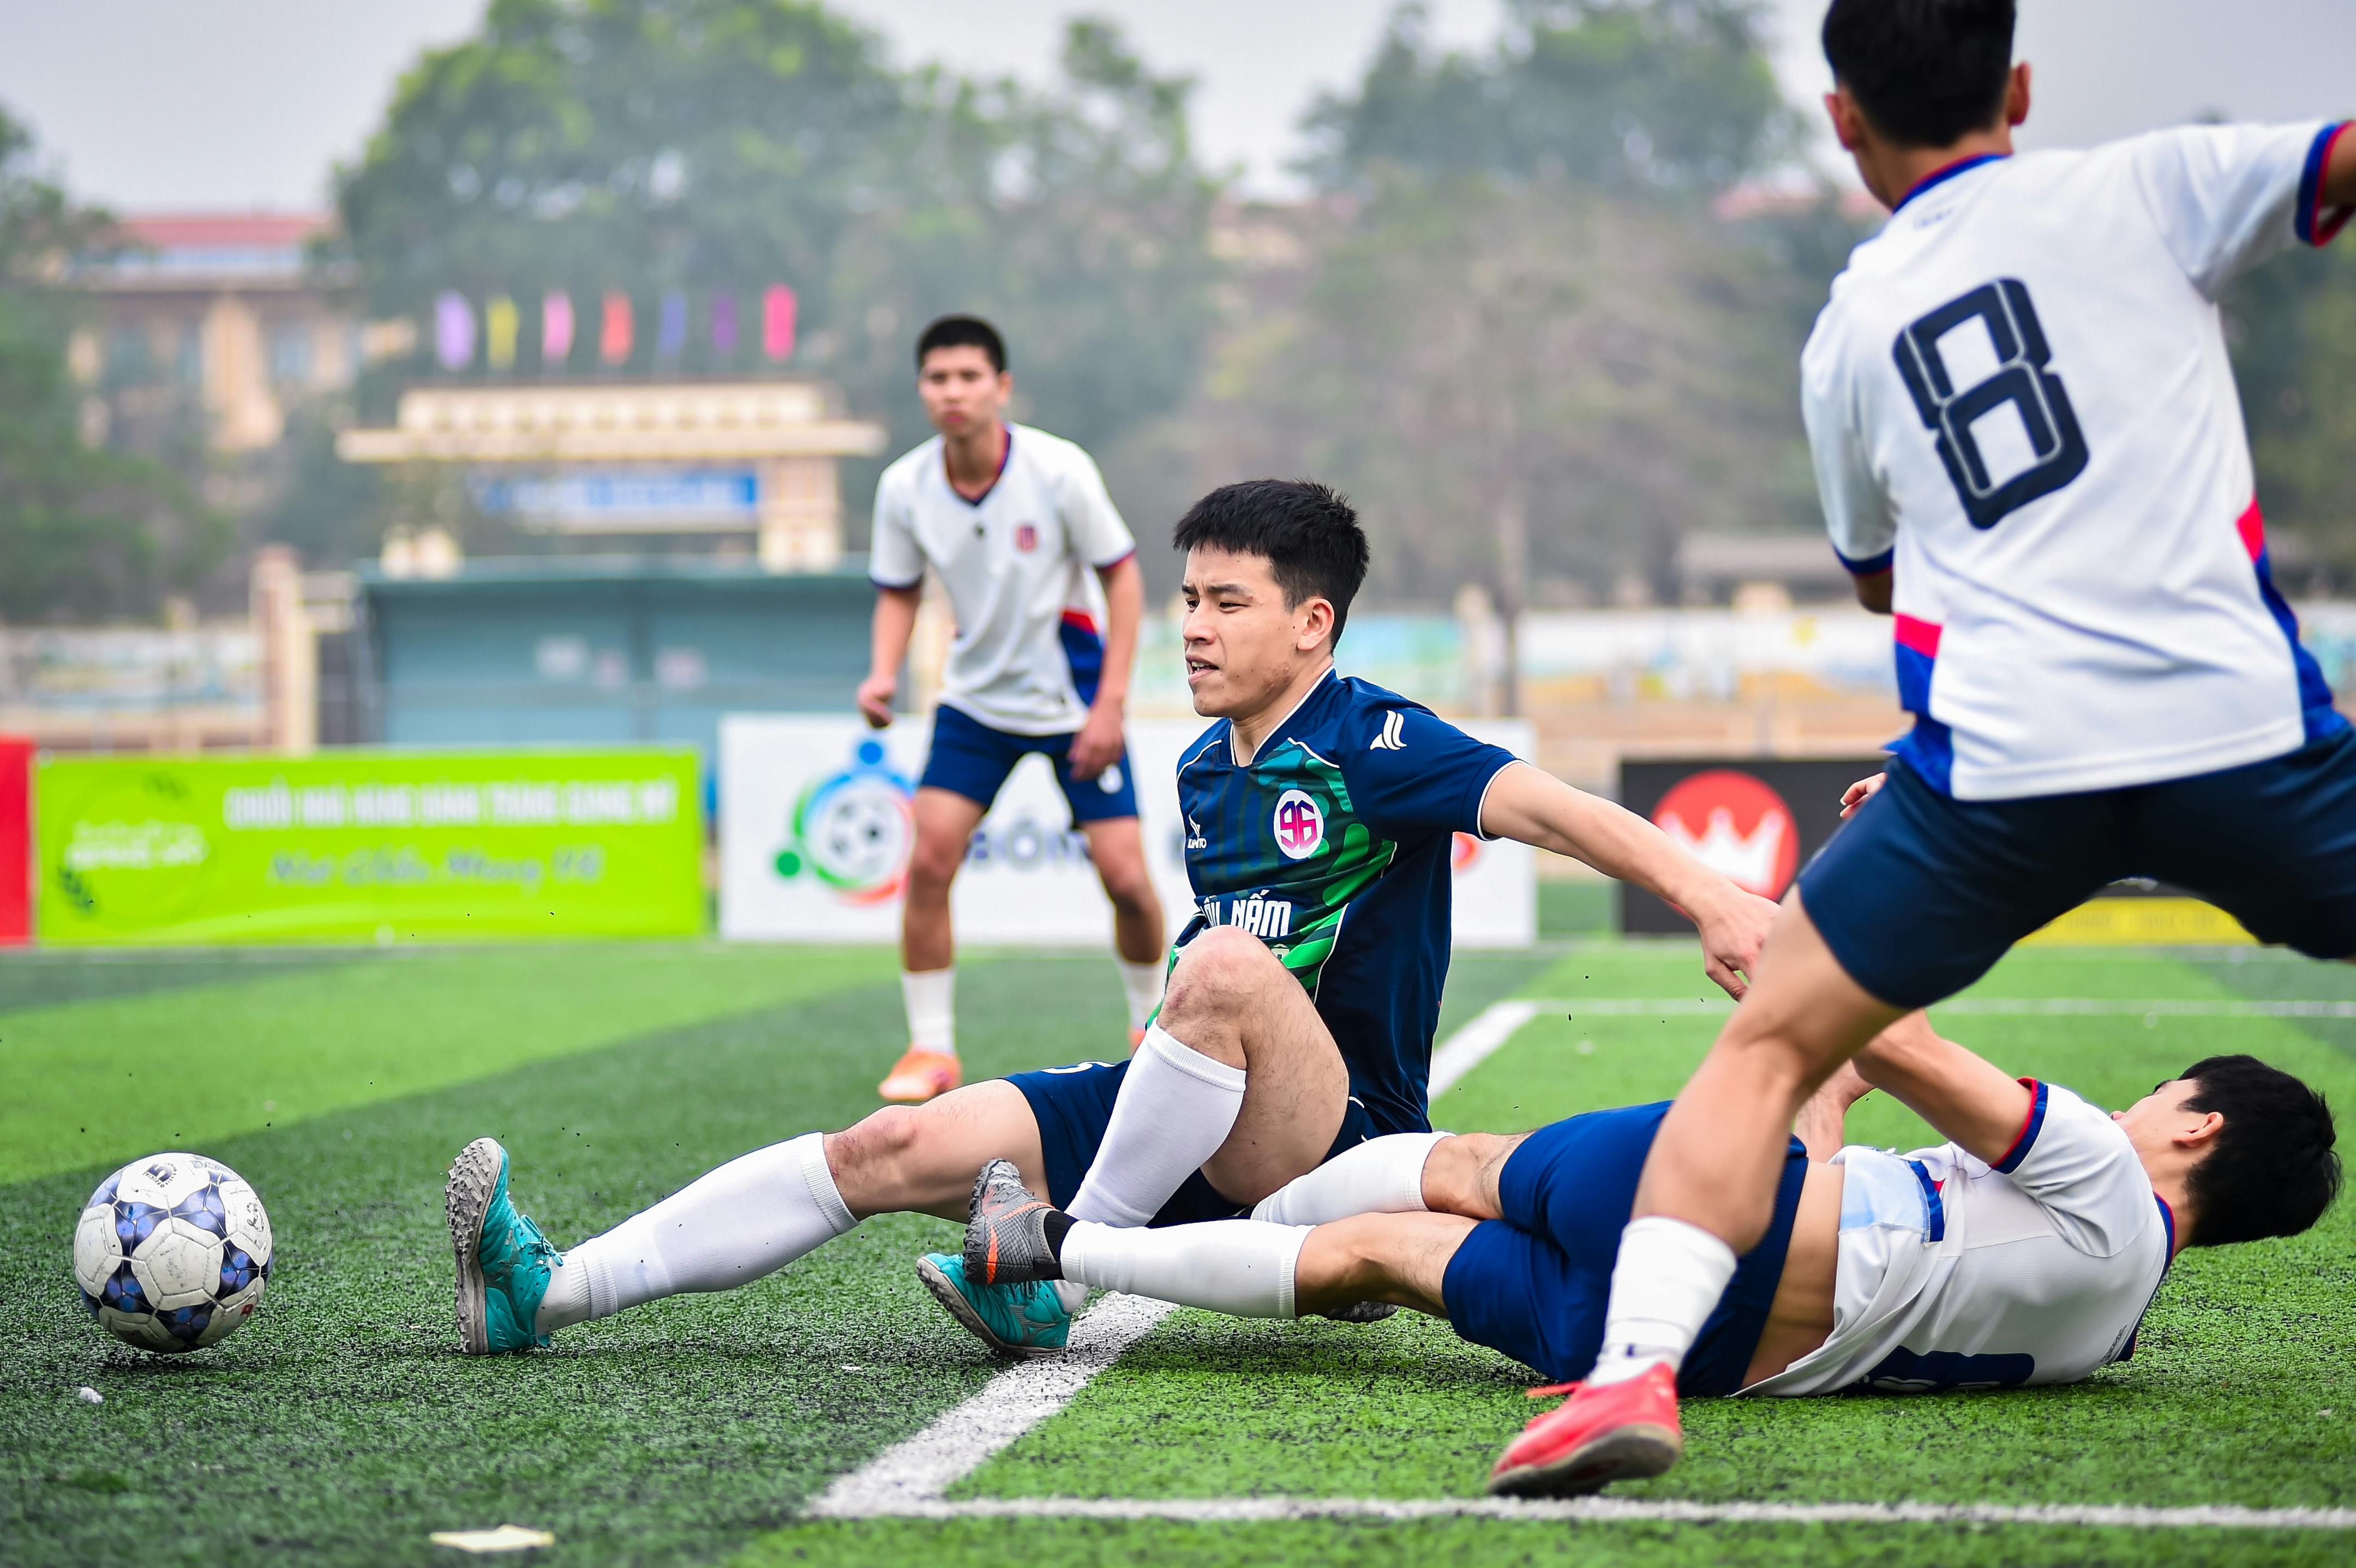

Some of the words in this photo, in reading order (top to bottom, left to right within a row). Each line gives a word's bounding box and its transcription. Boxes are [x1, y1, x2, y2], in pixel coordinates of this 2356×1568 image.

[1892, 277, 2090, 531] 8
[1279, 800, 1317, 850] 96
[1231, 890, 1291, 938] NẤM
